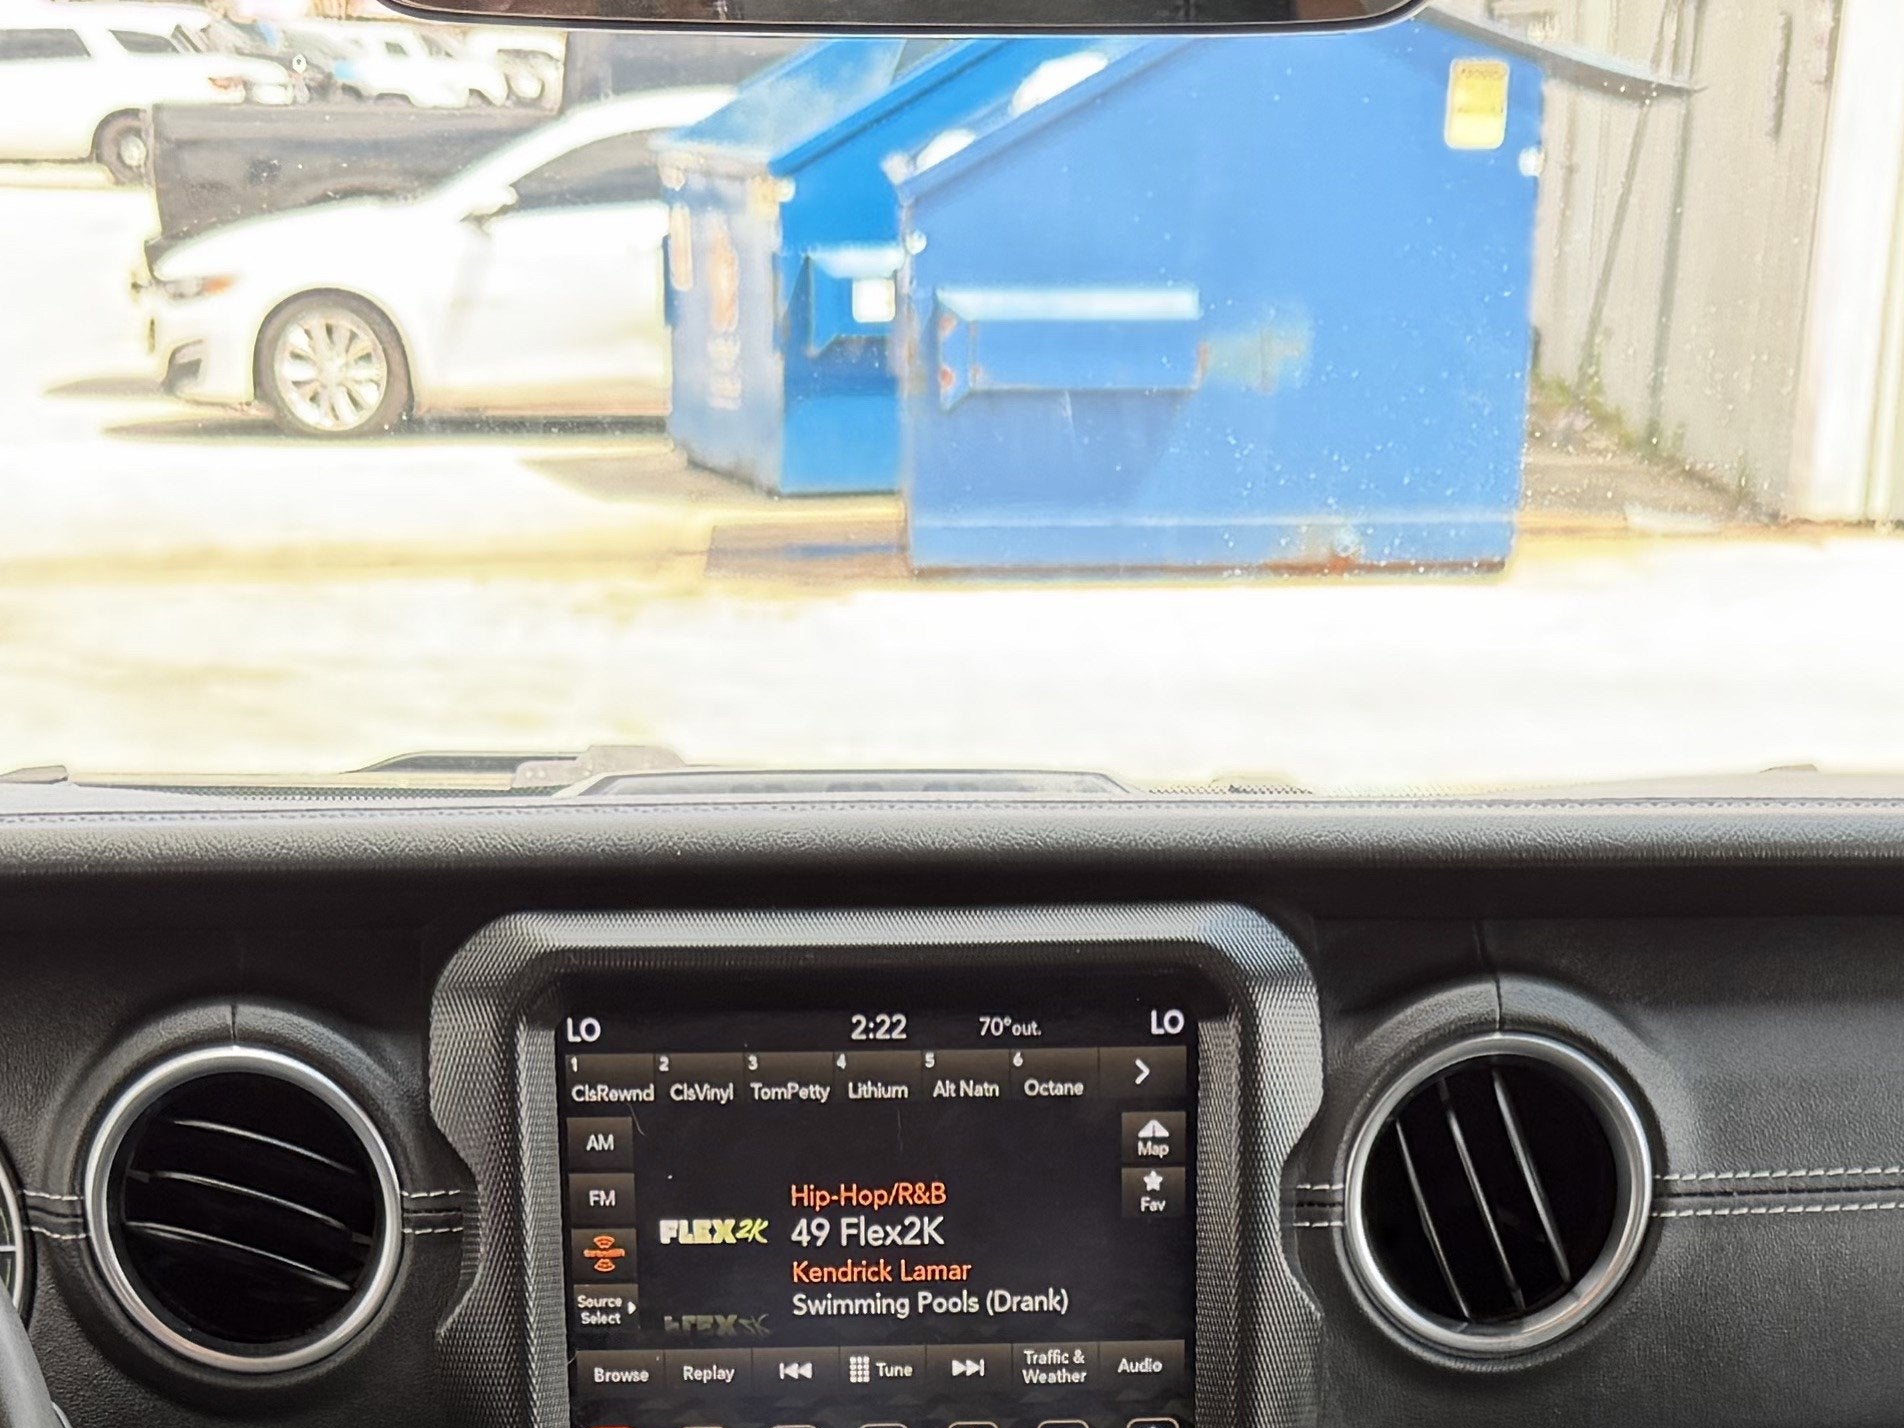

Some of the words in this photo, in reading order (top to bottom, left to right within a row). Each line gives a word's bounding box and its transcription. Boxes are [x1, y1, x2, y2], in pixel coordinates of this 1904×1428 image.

[566, 1017, 602, 1042] LO
[851, 1013, 907, 1040] 2:22
[1151, 1009, 1185, 1035] LO
[570, 1057, 578, 1073] 1
[659, 1056, 670, 1072] 2
[748, 1054, 758, 1071] 3
[836, 1053, 846, 1069] 4
[924, 1053, 935, 1068] 5
[1013, 1051, 1024, 1067] 6
[571, 1084, 655, 1102] ClsRewnd
[670, 1083, 734, 1105] ClsVinyl
[750, 1082, 831, 1103] TomPetty
[848, 1080, 908, 1099] Lithium
[933, 1080, 956, 1098] Alt
[959, 1080, 1000, 1098] Natn
[1024, 1078, 1084, 1096] Octane
[586, 1134, 614, 1151] AM
[1138, 1141, 1169, 1158] Map
[589, 1190, 616, 1207] FM
[791, 1182, 947, 1211] Hip-Hop/R&B
[1140, 1196, 1166, 1213] Fav
[659, 1218, 769, 1245] FLEX2K
[791, 1217, 831, 1247] 49
[840, 1215, 945, 1247] Flex2K
[792, 1258, 893, 1283] Kendrick
[900, 1259, 972, 1282] Lamar
[577, 1295, 622, 1309] Source
[792, 1292, 910, 1318] Swimming
[917, 1289, 979, 1313] Pools
[986, 1287, 1068, 1316] (Drank)
[581, 1312, 622, 1325] Select
[1024, 1350, 1069, 1365] Traffic
[1073, 1350, 1085, 1365] &
[1117, 1358, 1163, 1373] Audio
[594, 1367, 649, 1383] Browse
[683, 1365, 735, 1383] Replay
[876, 1362, 913, 1378] Tune
[1022, 1368, 1087, 1384] Weather
